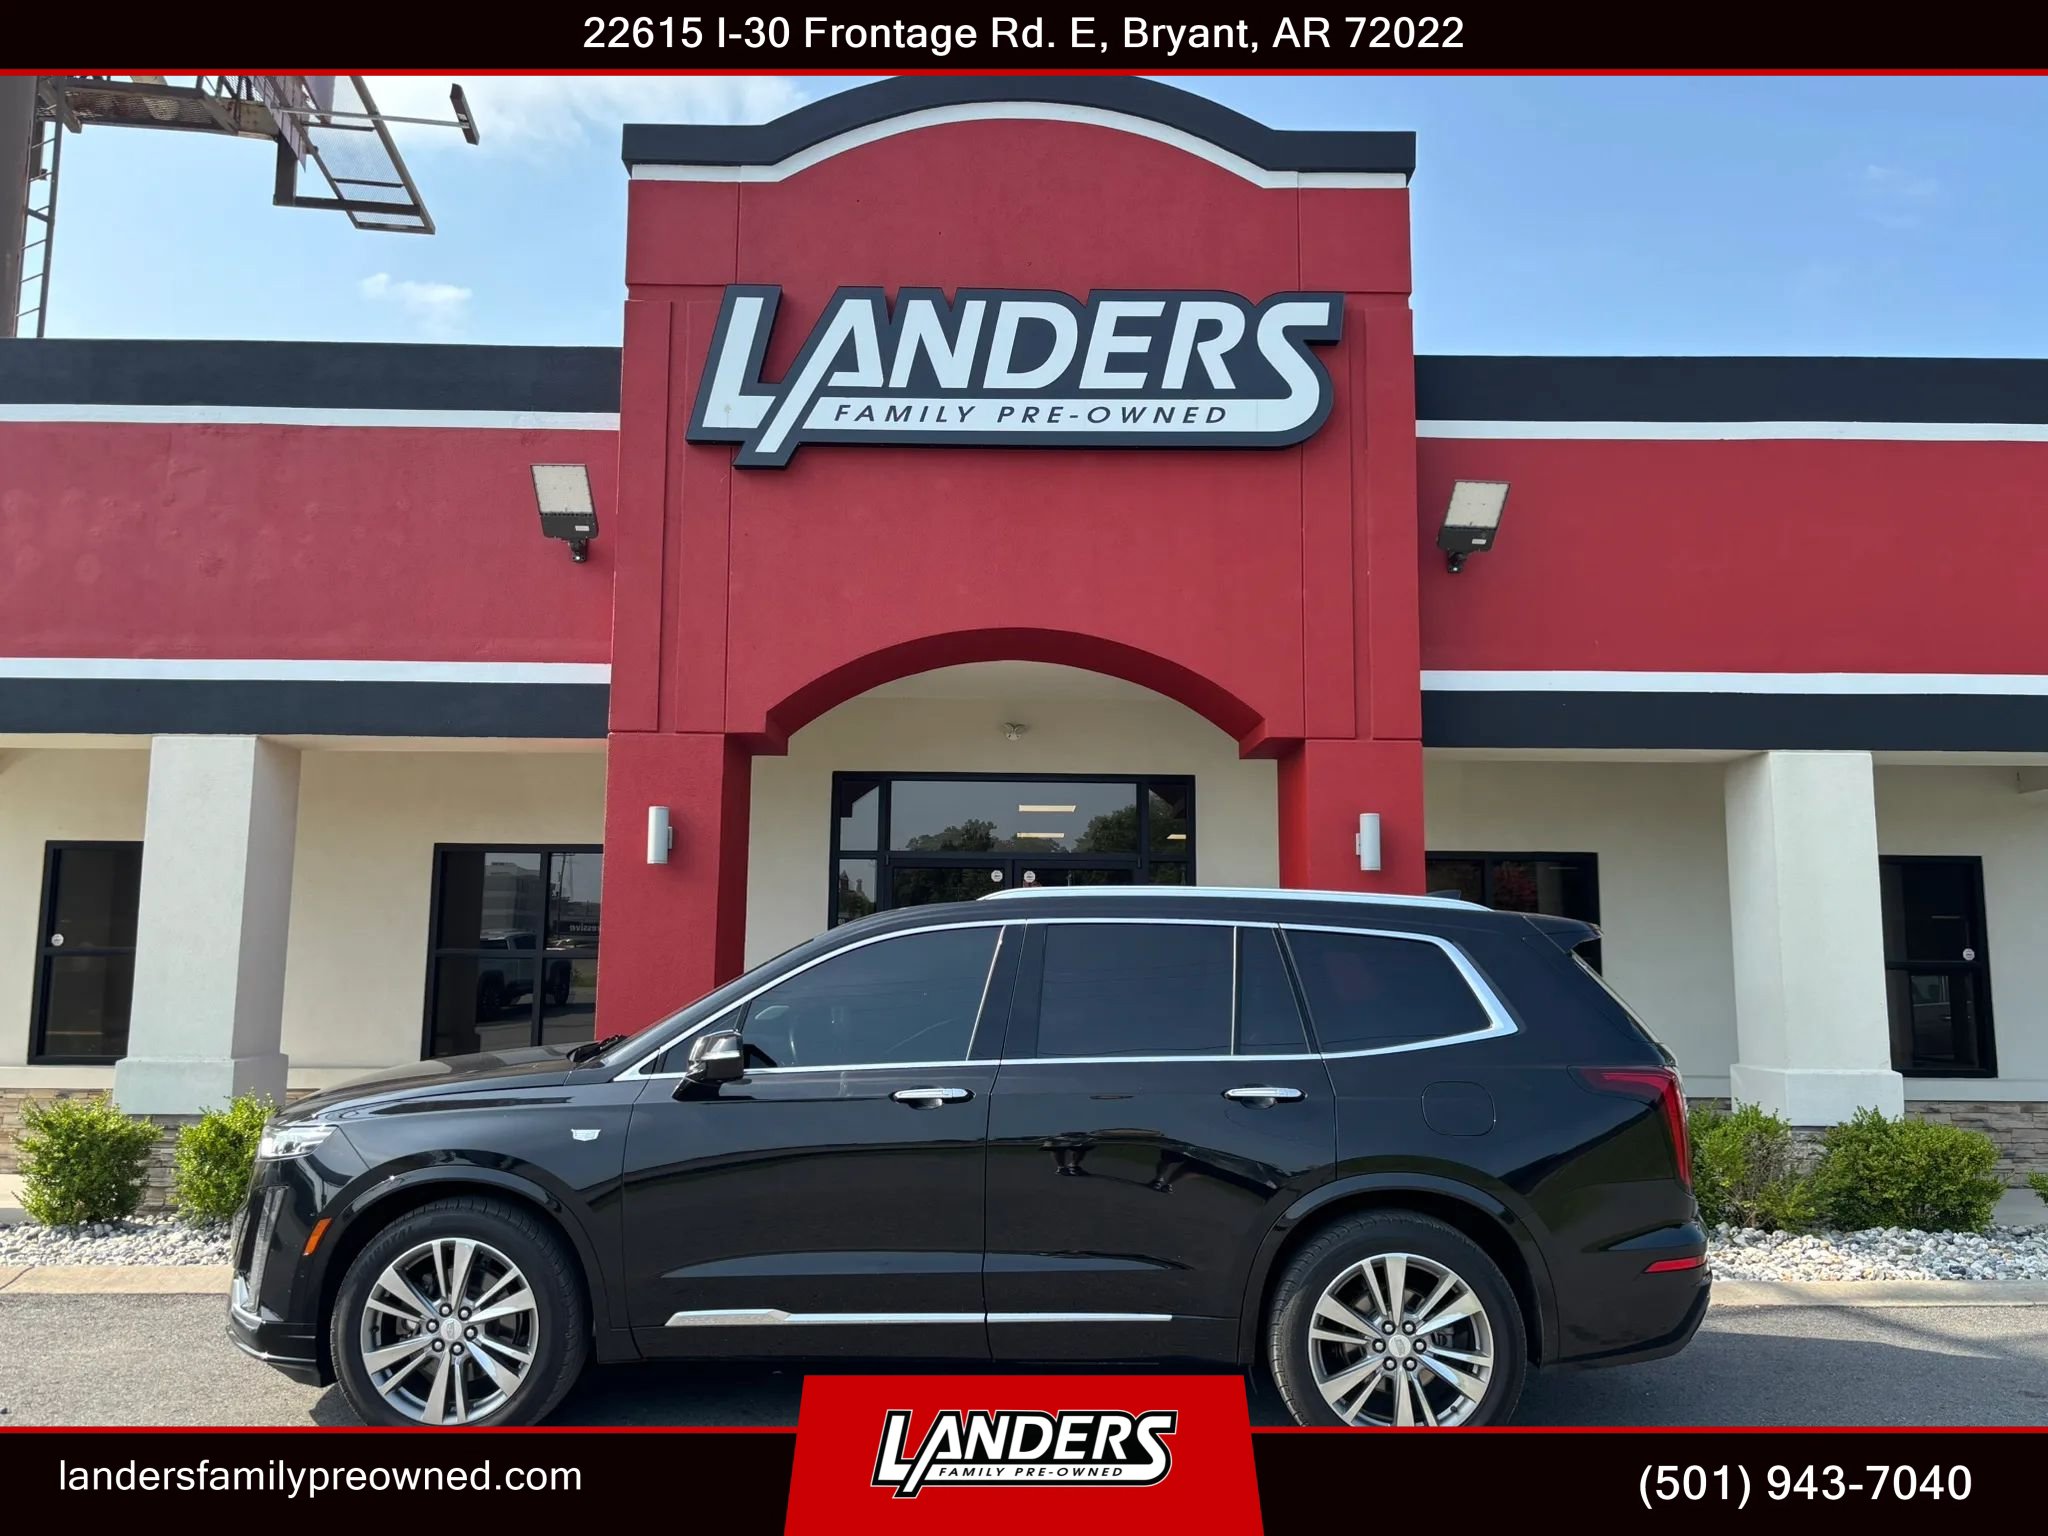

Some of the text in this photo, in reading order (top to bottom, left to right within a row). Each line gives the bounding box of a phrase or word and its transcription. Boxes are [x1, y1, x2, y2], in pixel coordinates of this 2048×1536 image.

[702, 296, 1330, 454] LANDERS
[834, 404, 1227, 424] FAMILY PRE-OWNED
